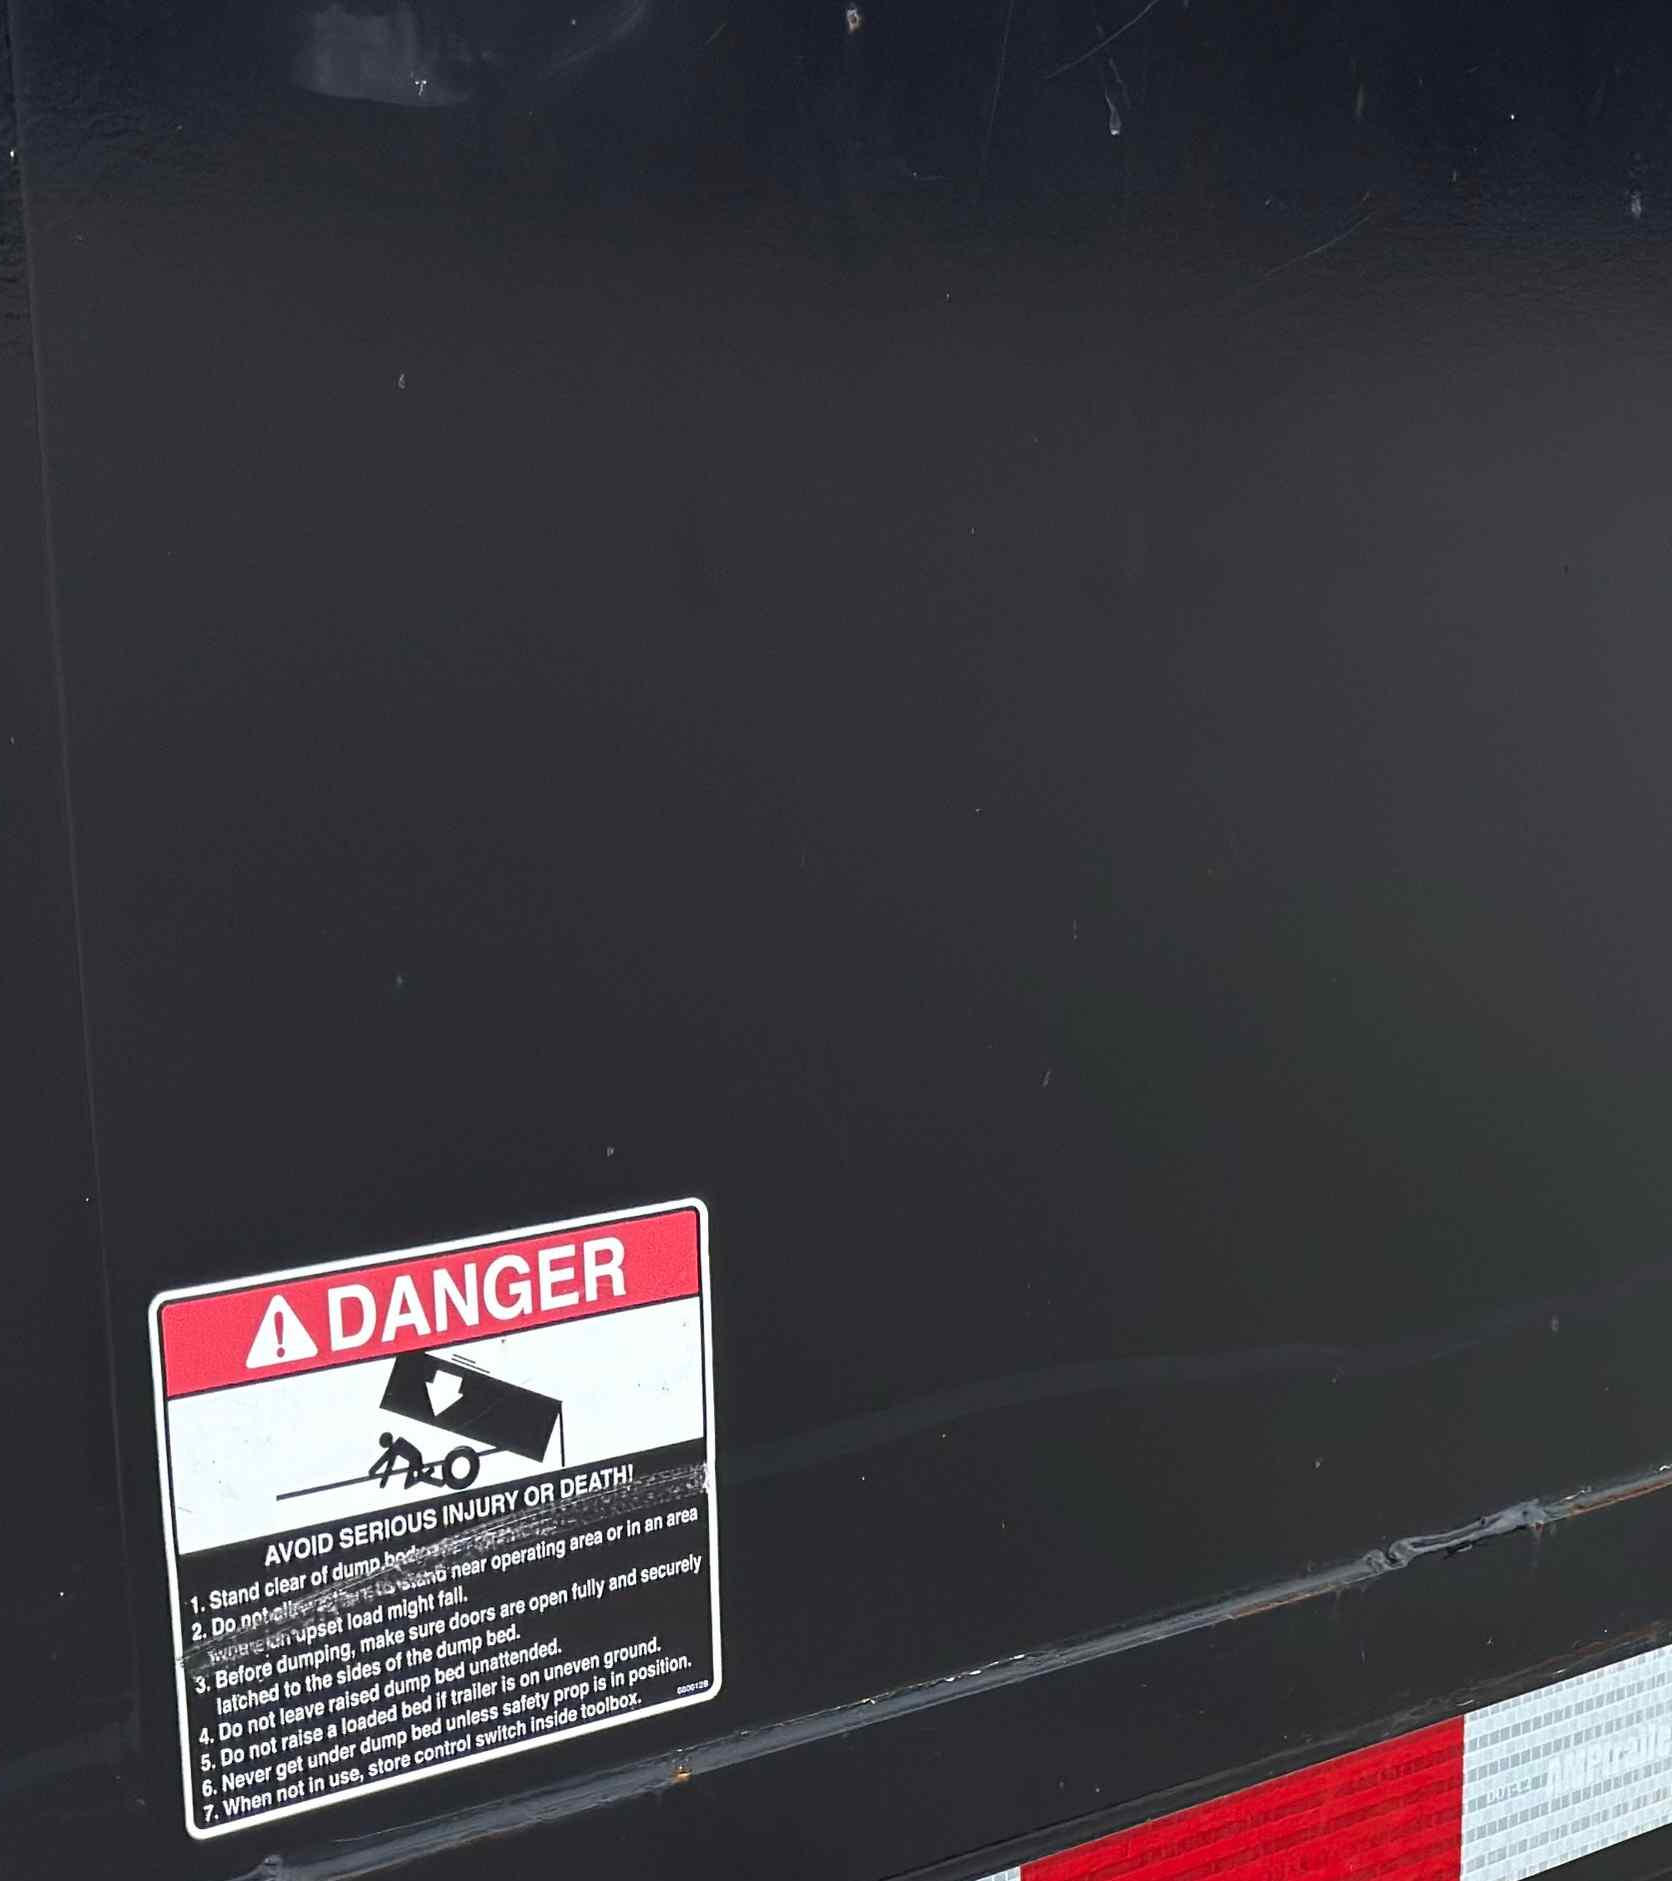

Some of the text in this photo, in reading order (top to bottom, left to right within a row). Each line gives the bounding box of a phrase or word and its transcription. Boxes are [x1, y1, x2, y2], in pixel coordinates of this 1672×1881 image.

[327, 1236, 627, 1353] DANGER
[264, 1532, 333, 1566] AVOID
[339, 1508, 437, 1548] SERIOUS
[442, 1489, 518, 1525] INJURY
[523, 1482, 554, 1506] OR
[560, 1463, 633, 1498] DEATH!
[190, 1557, 383, 1613] 1. Stand clear of dump
[191, 1620, 207, 1642] 2.
[210, 1613, 236, 1638] Do
[239, 1605, 270, 1631] not
[451, 1558, 487, 1579] near
[490, 1539, 565, 1571] operating
[569, 1530, 602, 1550] area
[606, 1525, 623, 1540] or
[626, 1519, 640, 1536] in
[644, 1515, 662, 1532] an
[666, 1507, 697, 1527] area
[193, 1553, 701, 1693] 3. Before dumping, make sure doors are open fully and securely
[296, 1616, 343, 1644] upset
[347, 1604, 382, 1630] load
[387, 1593, 434, 1620] might
[437, 1585, 467, 1607] fall.
[198, 1637, 561, 1744] 4. Do not leave raised dump bed unattended.
[200, 1636, 661, 1771] 5. Do not raise a loaded bed if trailer is on uneven ground.
[202, 1655, 691, 1796] 6. Never get under dump bed unless safety prop is in position.
[216, 1623, 520, 1715] latched to the sides of the dump bed.
[203, 1692, 641, 1822] 7. When not in use, store control switch inside toolbox.
